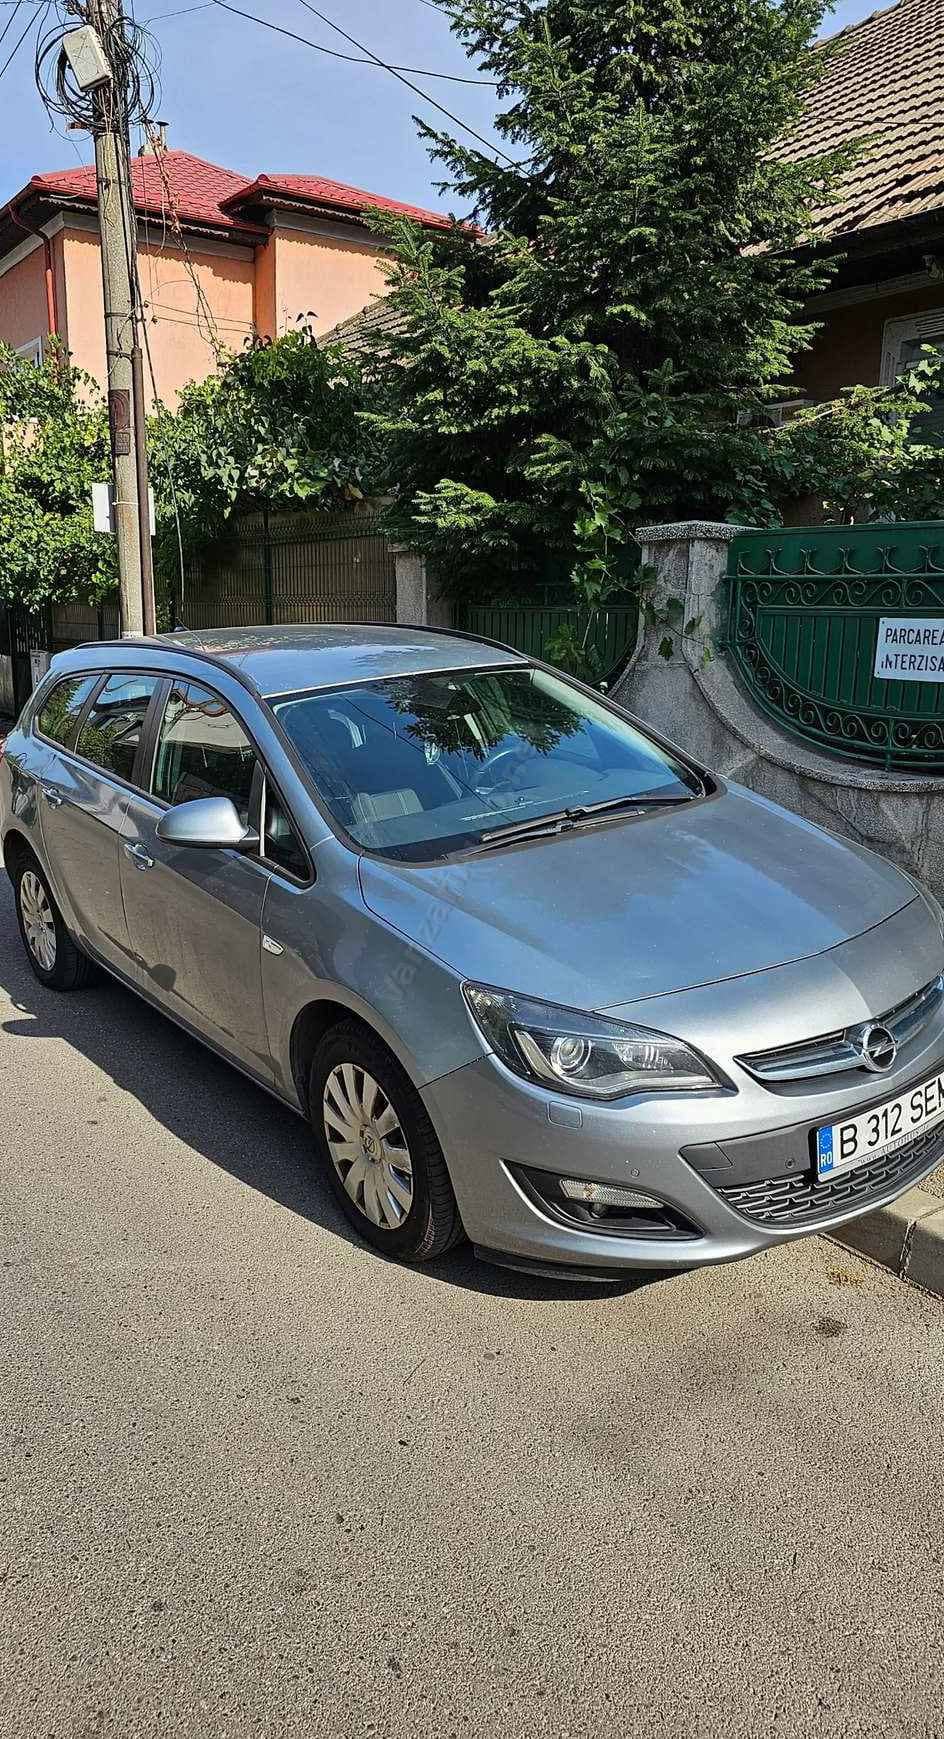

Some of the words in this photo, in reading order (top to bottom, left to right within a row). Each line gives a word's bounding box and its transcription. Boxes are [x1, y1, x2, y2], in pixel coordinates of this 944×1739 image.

[840, 1124, 858, 1160] B
[867, 1103, 902, 1146] 312
[820, 1152, 832, 1167] RO
